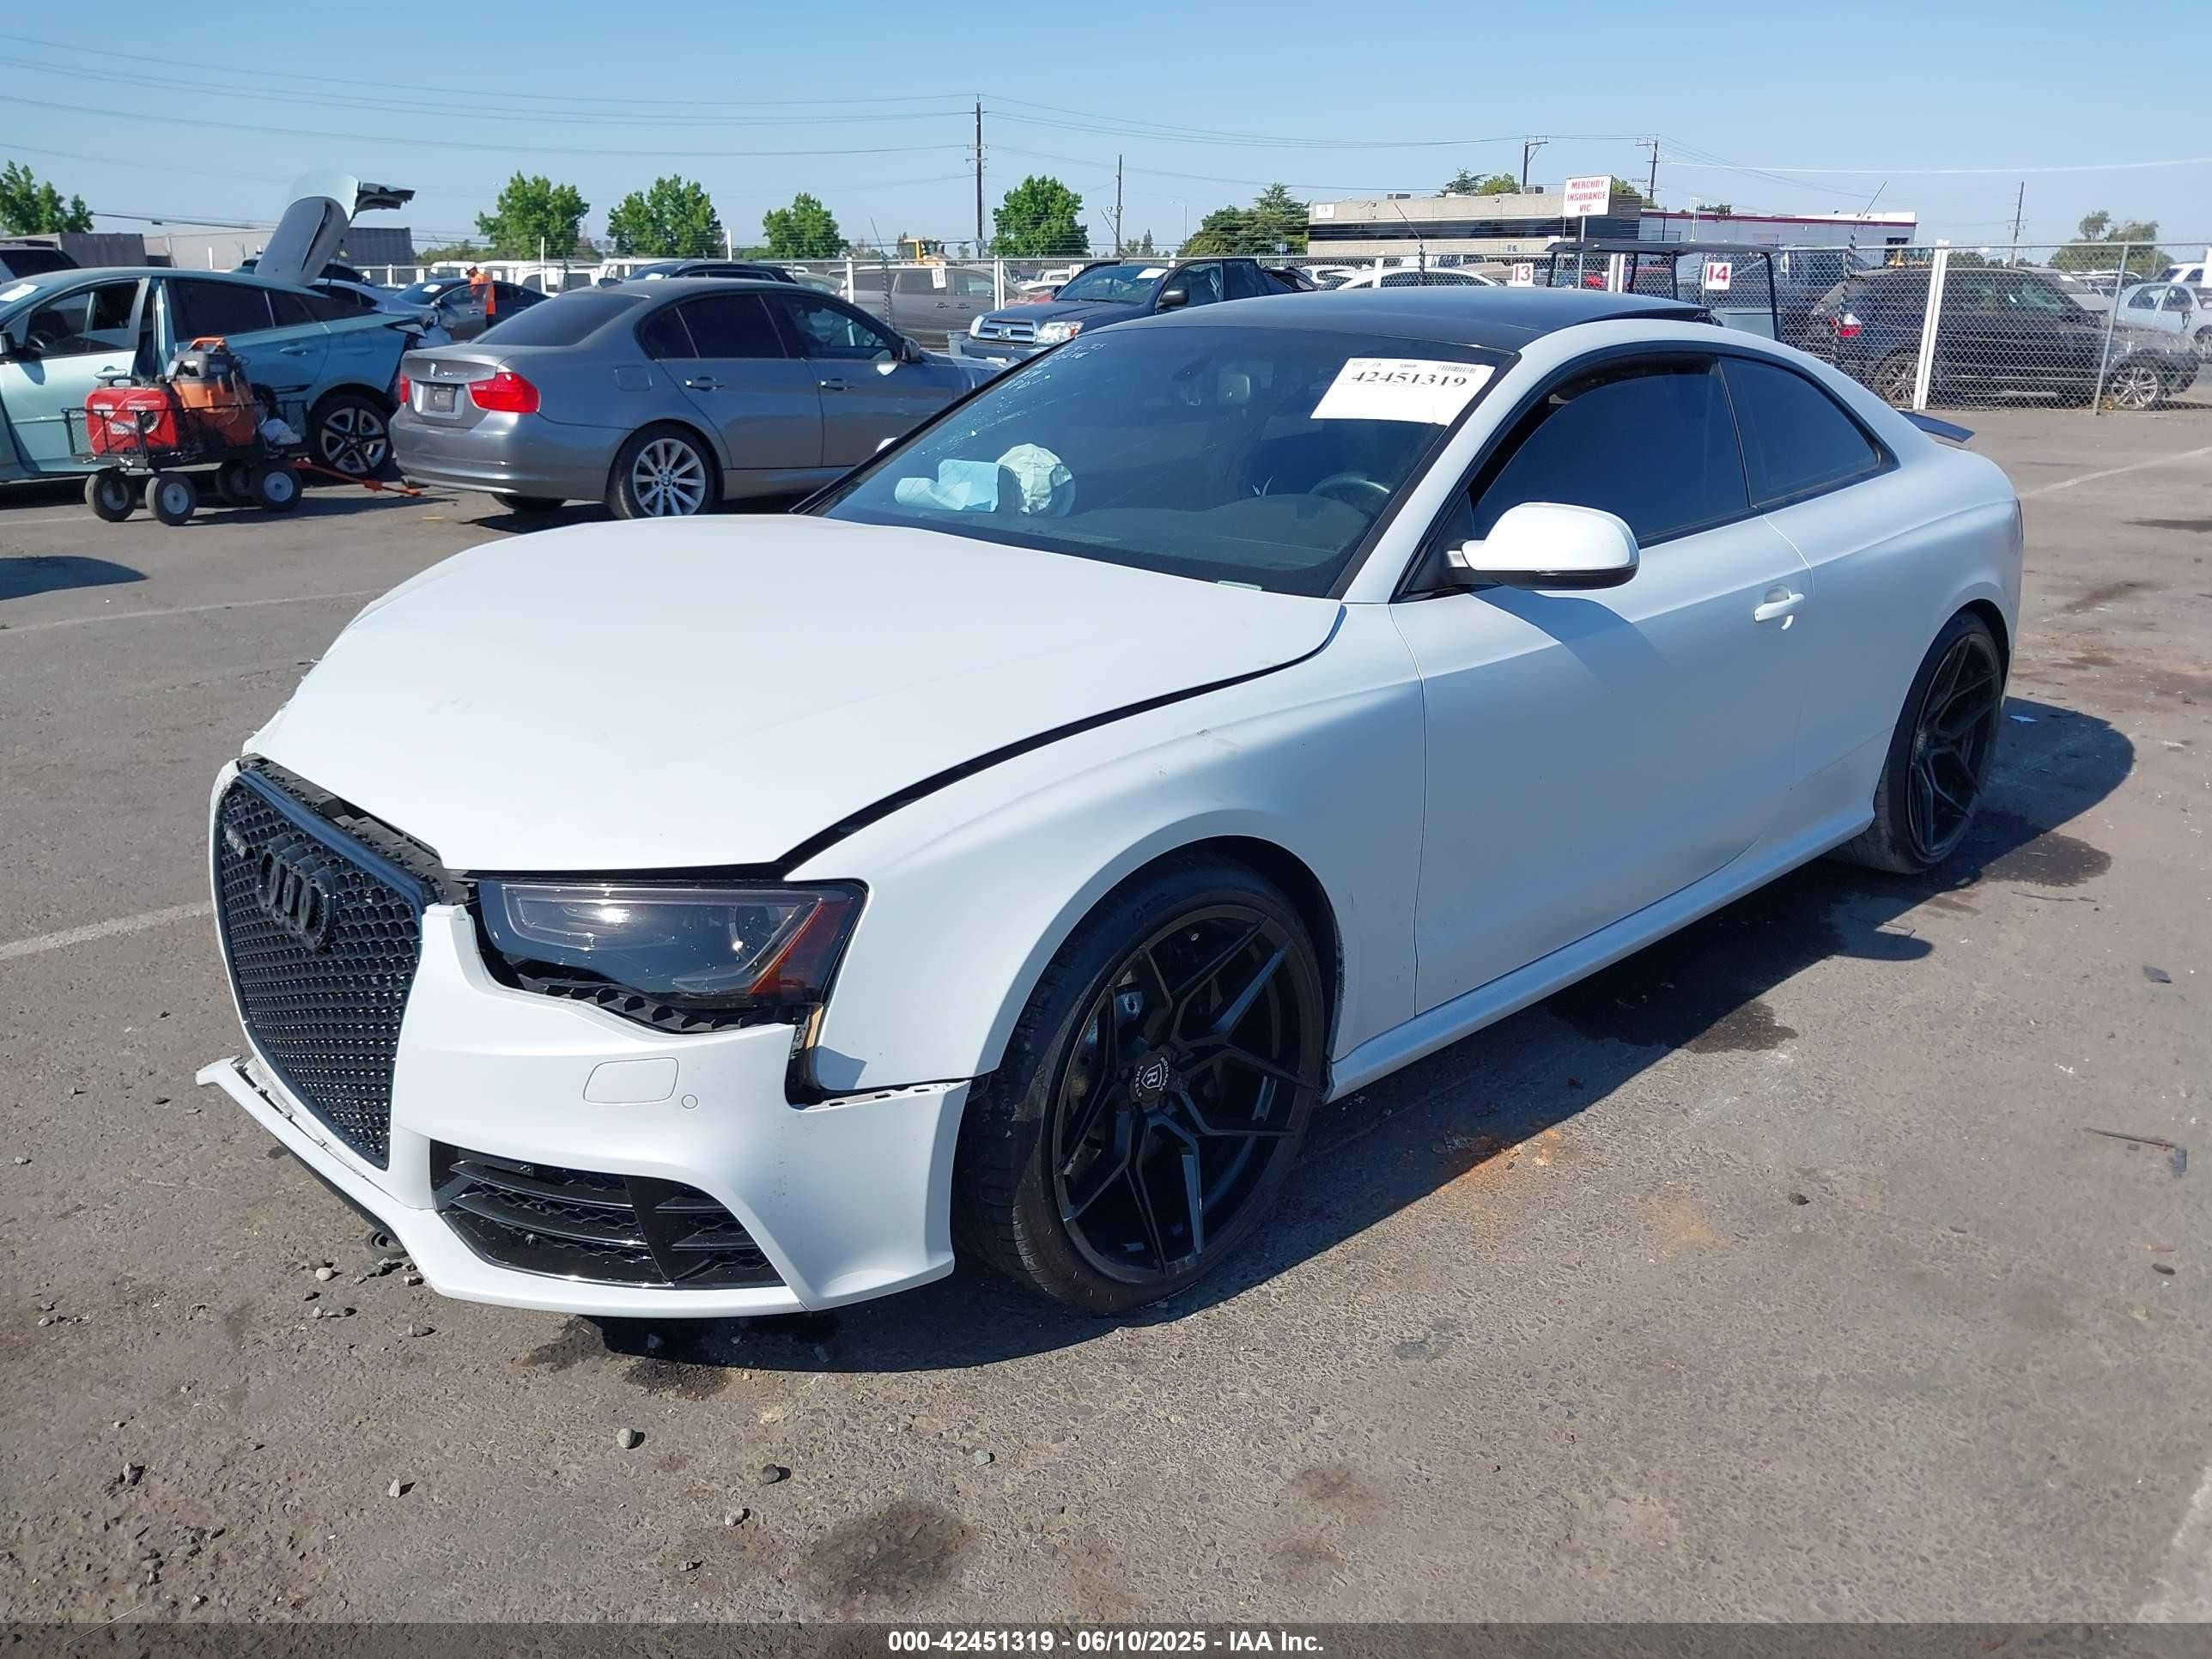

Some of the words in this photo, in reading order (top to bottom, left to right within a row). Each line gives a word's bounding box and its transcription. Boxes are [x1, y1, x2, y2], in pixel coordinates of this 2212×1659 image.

[1571, 179, 1604, 190] MERCURY
[1567, 191, 1607, 202] INSURANCE
[1579, 204, 1592, 213] VIC
[934, 270, 945, 283] 10
[1515, 265, 1531, 282] 13
[1708, 264, 1729, 282] 14
[1351, 371, 1468, 386] 42451319
